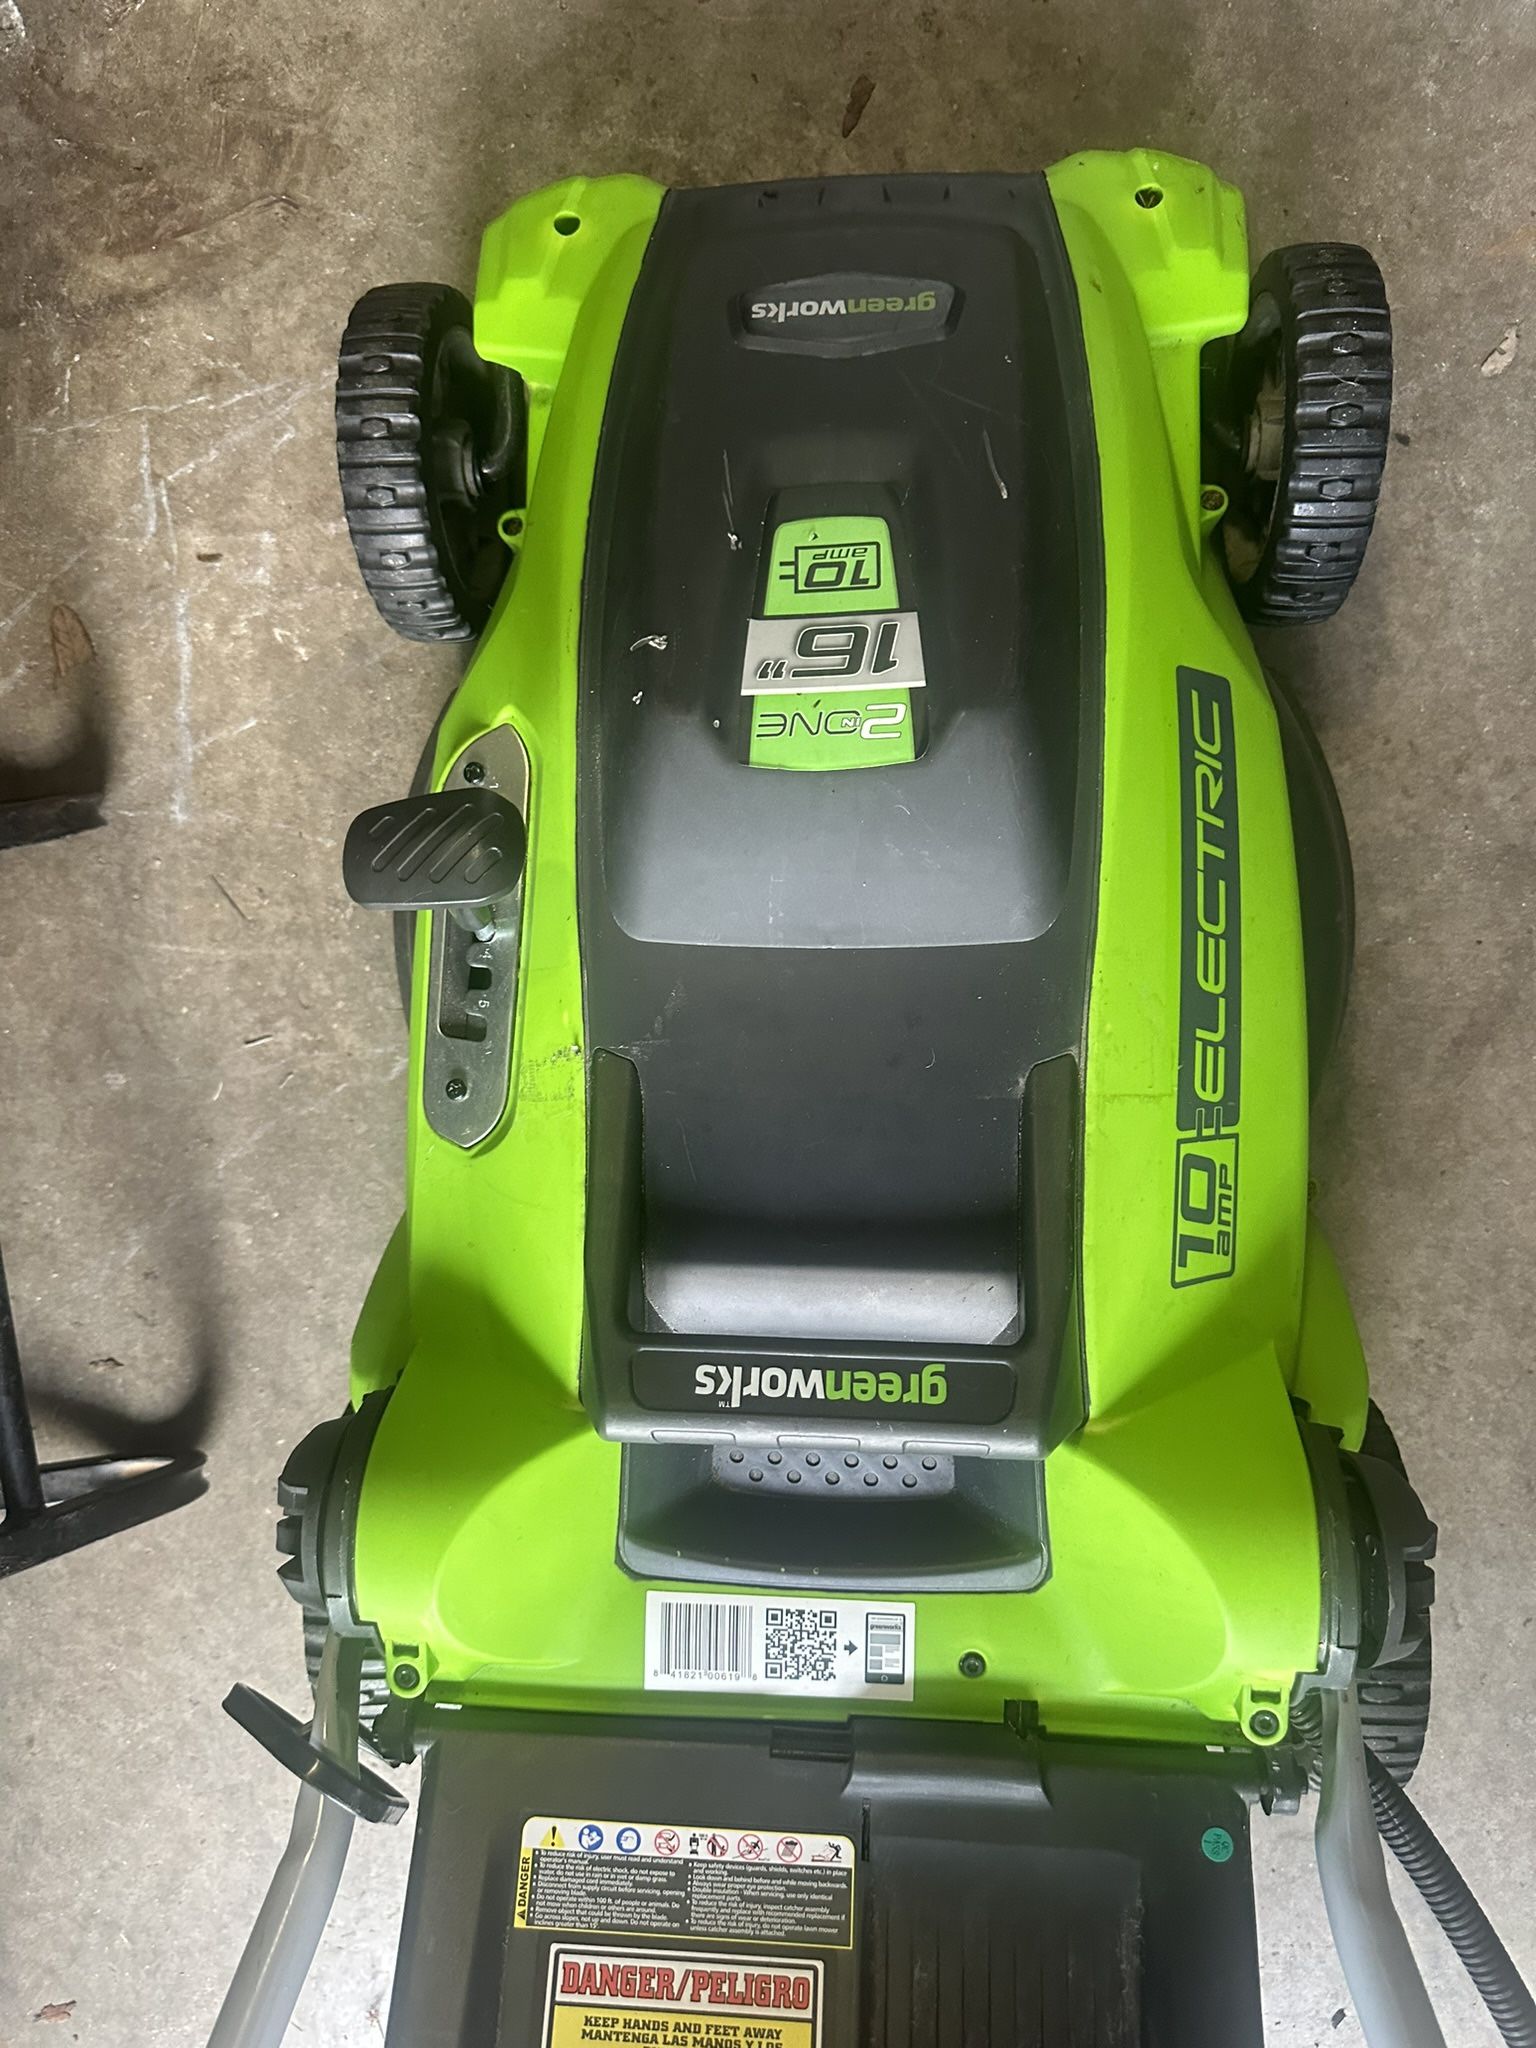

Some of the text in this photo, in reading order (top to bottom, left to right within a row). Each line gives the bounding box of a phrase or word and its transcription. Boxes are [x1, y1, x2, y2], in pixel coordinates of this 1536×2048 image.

[751, 291, 937, 323] greenworks
[804, 559, 871, 588] 10
[755, 710, 861, 738] ONE
[860, 702, 907, 740] 2
[1191, 688, 1227, 1103] ELECTRIC
[478, 999, 490, 1009] 5
[1177, 1153, 1217, 1269] 10
[694, 1363, 948, 1408] greenworks
[693, 1861, 707, 1869] Keep
[708, 1862, 724, 1870] safety
[832, 1869, 847, 1877] place
[517, 1856, 531, 1907] DANGER
[538, 1874, 558, 1882] Replace
[559, 1875, 585, 1884] damaged
[692, 1880, 711, 1888] Always
[797, 1879, 817, 1887] moving
[543, 1887, 569, 1896] removing
[582, 1883, 599, 1891] supply
[662, 1888, 685, 1897] opening
[796, 1892, 808, 1900] only
[555, 1894, 577, 1903] operate
[621, 1899, 640, 1907] people
[557, 1907, 574, 1915] object
[762, 1903, 782, 1911] inspect
[804, 1905, 829, 1914] assembly
[649, 1920, 670, 1928] operate
[781, 1923, 802, 1932] operate
[560, 1961, 811, 2010] DANGER/PELIGRO
[584, 2015, 783, 2040] KEEP HANDS AND FEET AWAY
[581, 2028, 659, 2044] MANTENGA
[662, 2034, 688, 2046] LAS
[692, 2036, 742, 2048] MANOS
